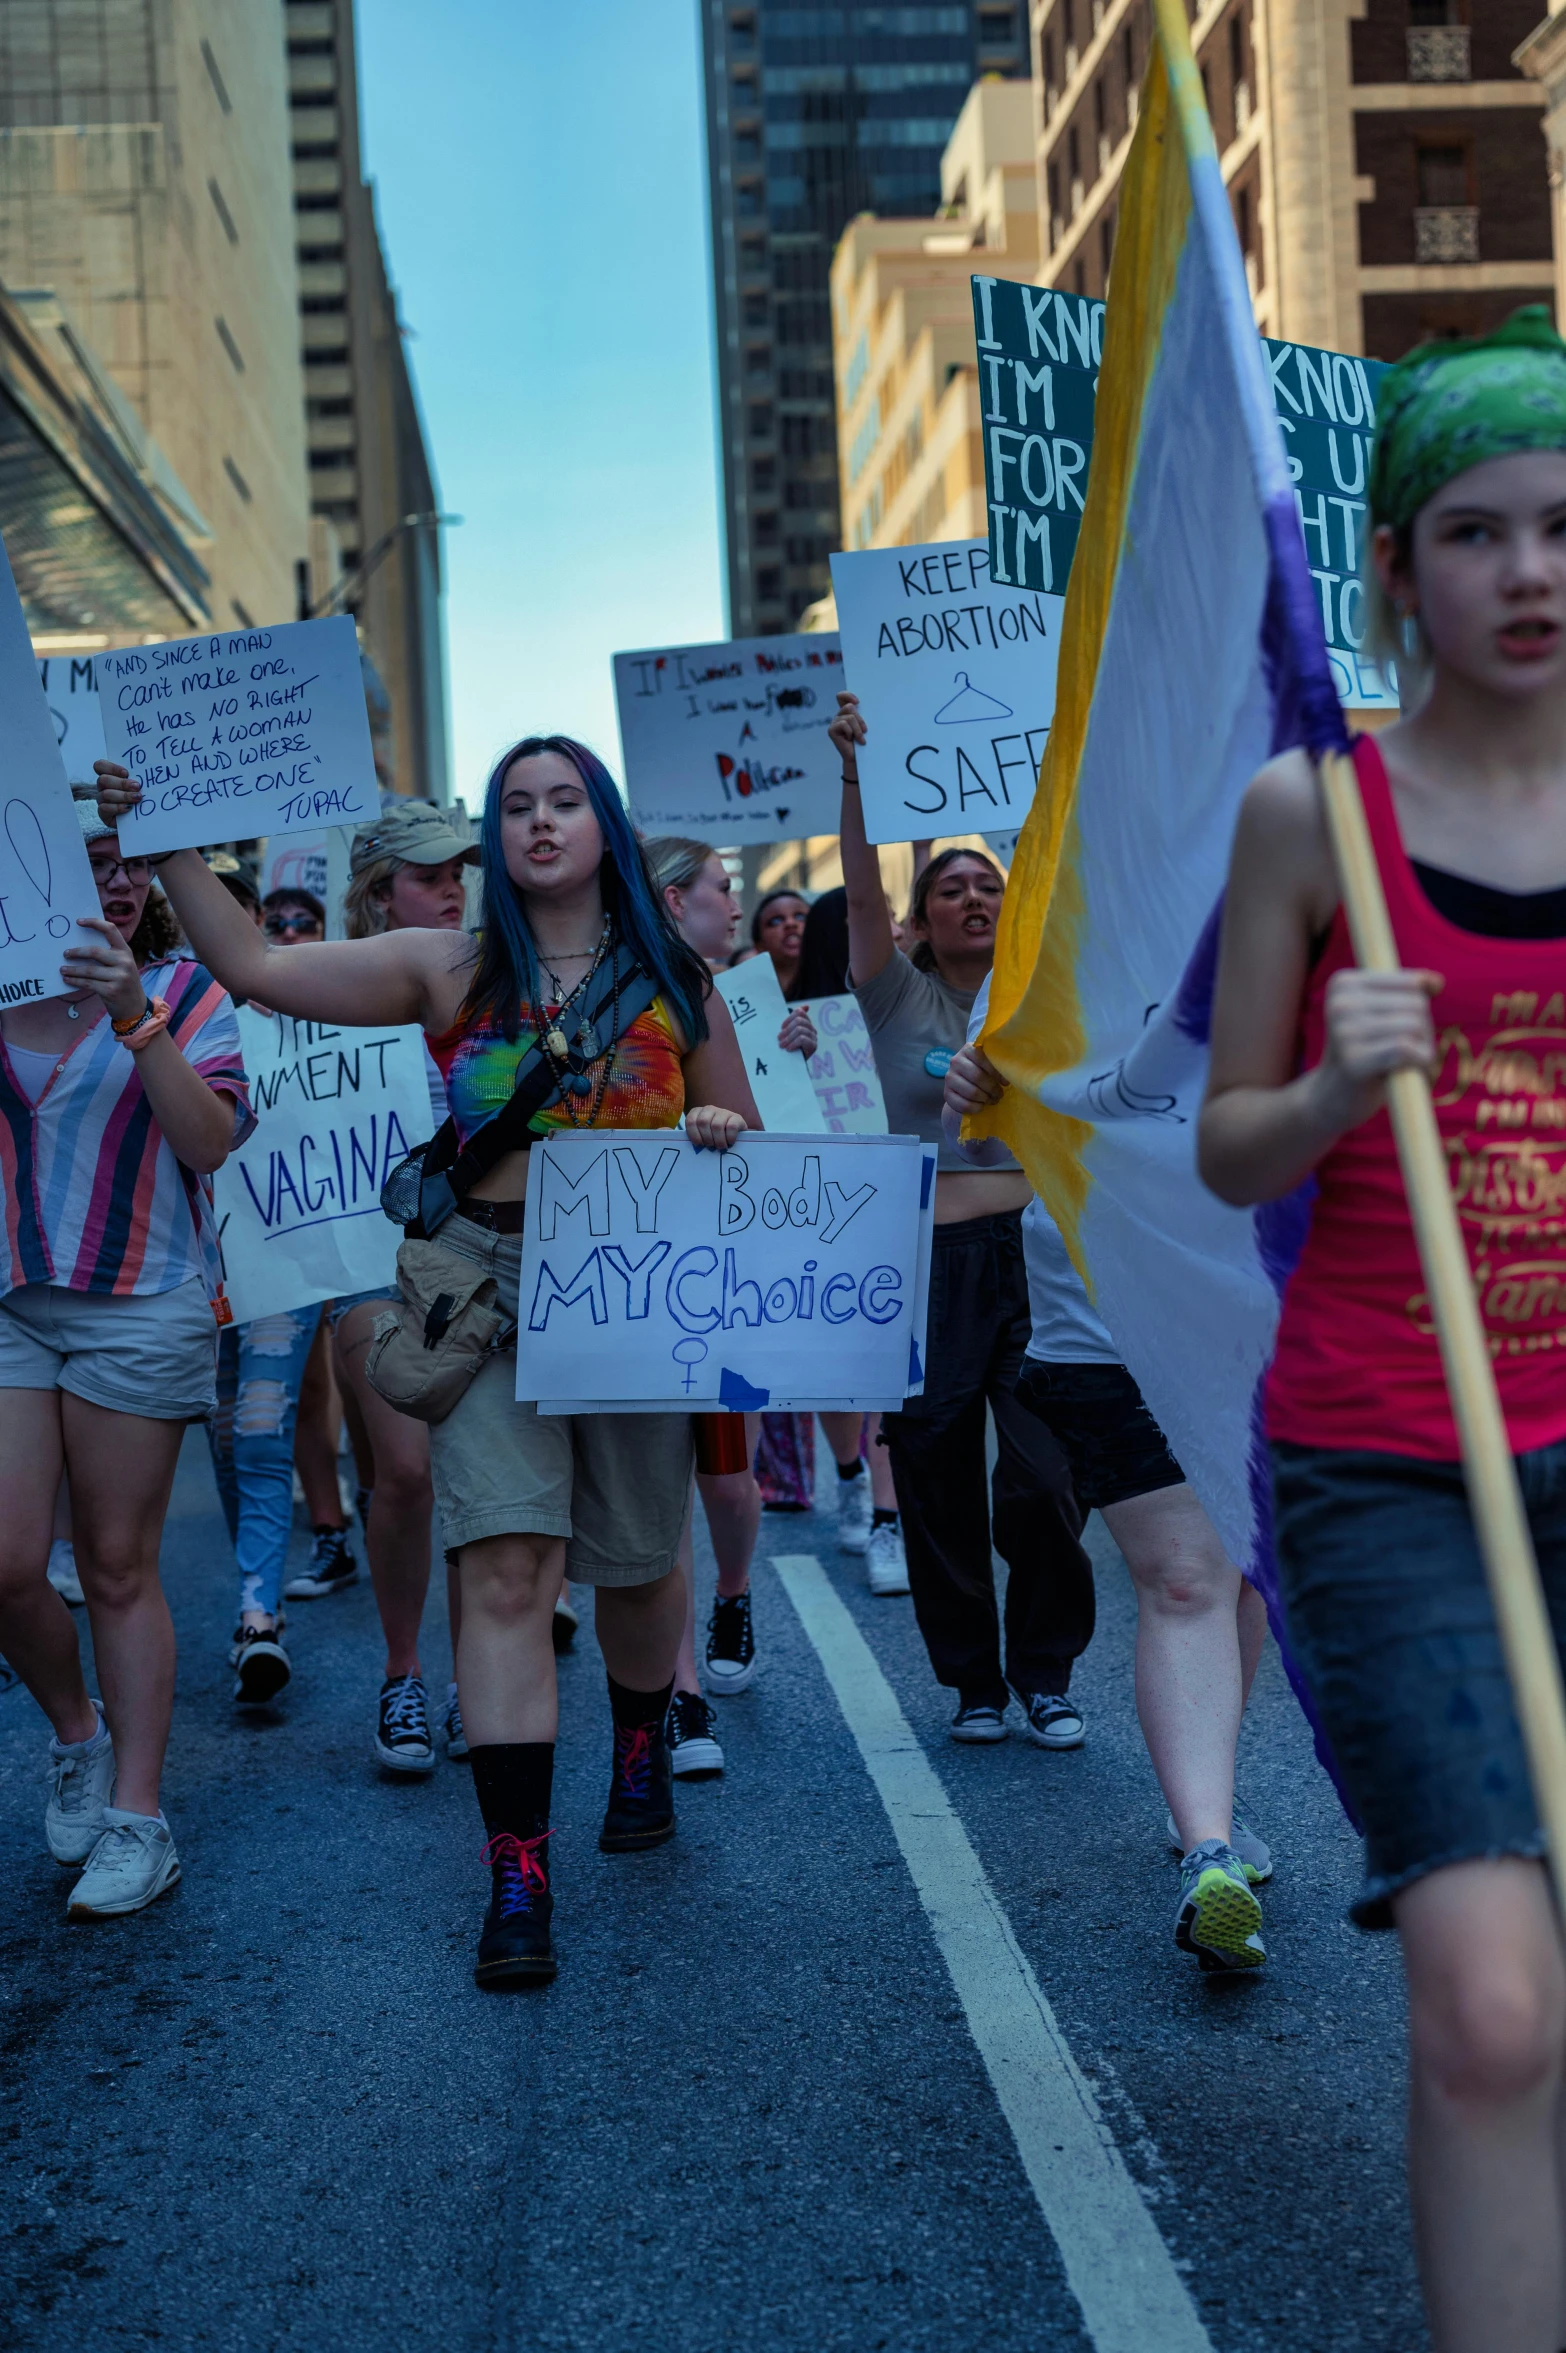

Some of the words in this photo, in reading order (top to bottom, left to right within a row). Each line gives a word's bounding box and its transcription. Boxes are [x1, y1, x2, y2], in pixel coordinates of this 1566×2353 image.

[973, 275, 1003, 351] I
[983, 354, 1055, 430] I'M
[1328, 428, 1375, 495] U
[989, 426, 1086, 513] FOR
[898, 548, 990, 597] KEEP
[989, 503, 1054, 592] I'M
[151, 643, 203, 670] SINCE
[210, 637, 222, 660] A
[228, 633, 273, 657] MAN
[877, 594, 1047, 658] ABORTION
[118, 677, 173, 711] Can't
[181, 665, 241, 696] make
[125, 717, 152, 738] He
[157, 711, 197, 732] has
[208, 698, 239, 722] NO
[247, 674, 321, 710] RIGHT
[121, 744, 147, 769] TO
[155, 735, 204, 760] TELL
[211, 726, 223, 746] A
[228, 708, 313, 743] WOMAN
[191, 751, 232, 775] AND
[239, 733, 312, 765] WHERE
[160, 774, 253, 811] CREATE
[278, 786, 364, 824] TUPAC
[755, 1057, 768, 1076] A
[239, 1110, 411, 1227] VAGINA
[538, 1147, 681, 1242] MY
[718, 1152, 878, 1244] Body
[528, 1240, 672, 1332] MY
[666, 1245, 903, 1335] Choice
